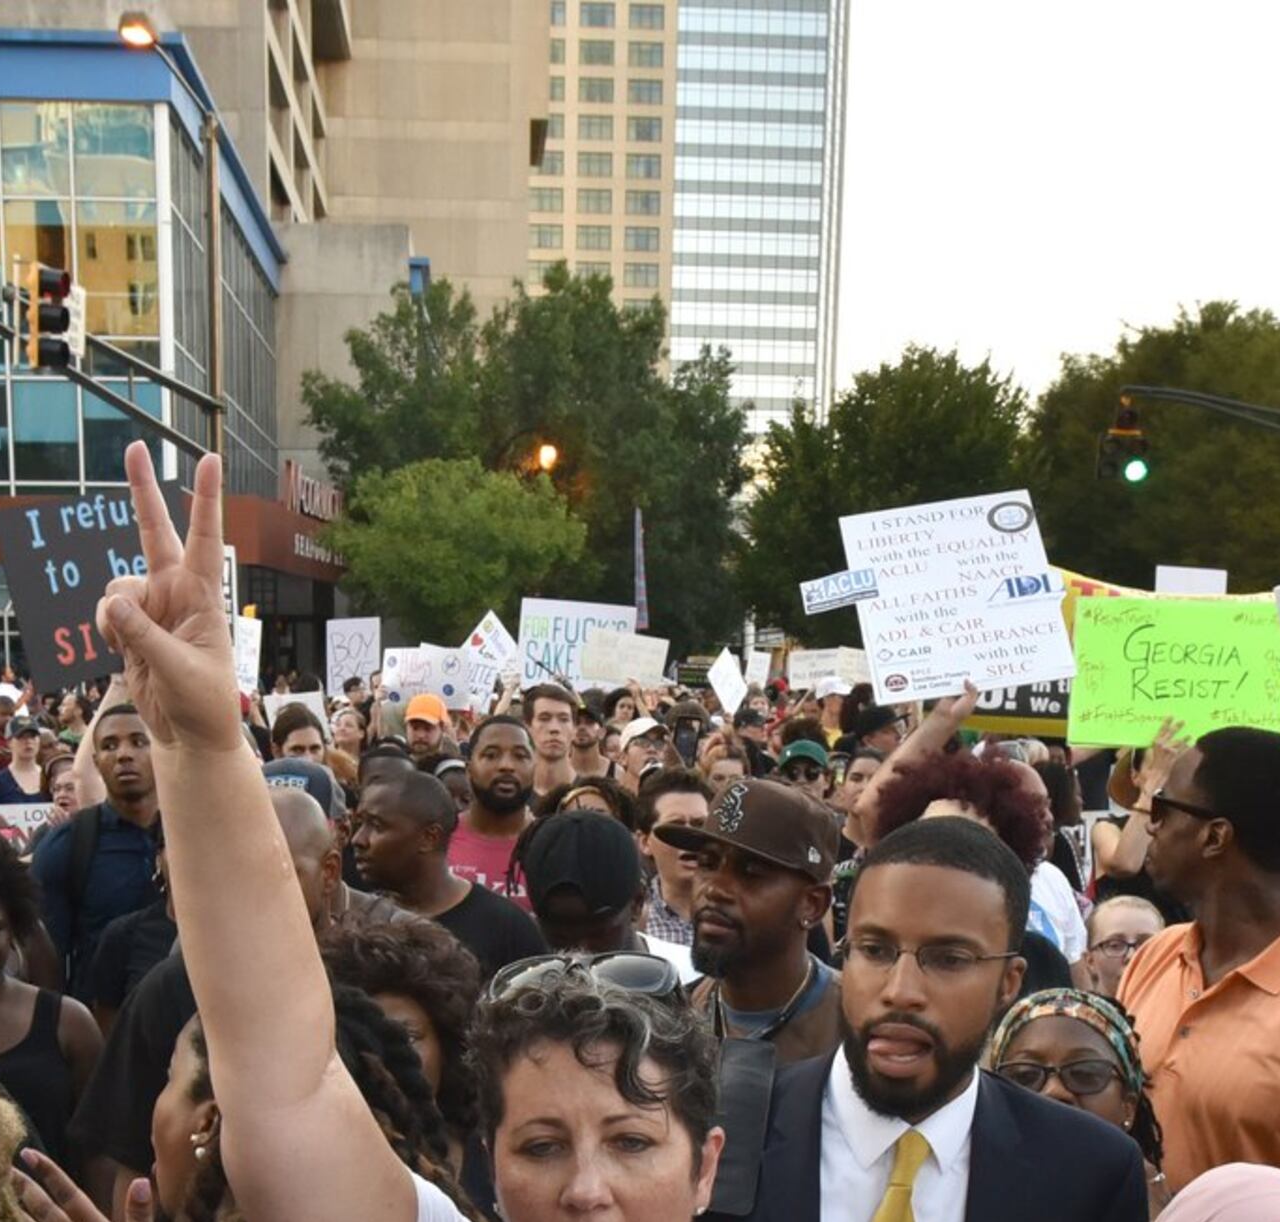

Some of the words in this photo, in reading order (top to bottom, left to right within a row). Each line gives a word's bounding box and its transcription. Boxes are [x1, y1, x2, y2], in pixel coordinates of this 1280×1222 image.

[26, 509, 45, 549] I
[880, 510, 945, 530] STAND
[949, 505, 986, 520] FOR
[856, 528, 935, 551] LIBERTY
[936, 531, 1031, 555] EQUALITY
[869, 550, 904, 566] with
[907, 546, 931, 560] the
[954, 553, 992, 568] with
[995, 549, 1019, 562] the
[44, 558, 81, 595] to
[107, 548, 148, 578] be
[877, 561, 929, 579] ACLU
[957, 564, 1025, 582] NAACP
[824, 568, 876, 597] ACLU
[989, 574, 1065, 601] ADL
[867, 597, 907, 614] ALL
[909, 585, 978, 607] FAITHS
[894, 607, 930, 625] with
[933, 604, 959, 618] the
[522, 615, 549, 640] FOR
[874, 631, 912, 645] ADL
[919, 625, 934, 638] &
[937, 617, 986, 636] CAIR
[942, 619, 1062, 649] TOLERANCE
[329, 631, 376, 664] BOY
[896, 646, 932, 659] CAIR
[973, 647, 1010, 662] with
[1013, 642, 1039, 657] the
[1123, 623, 1242, 669] GEORGIA
[985, 659, 1035, 678] SPLC
[1132, 667, 1249, 702] RESIST!
[1029, 697, 1062, 714] We
[24, 809, 52, 822] LOV
